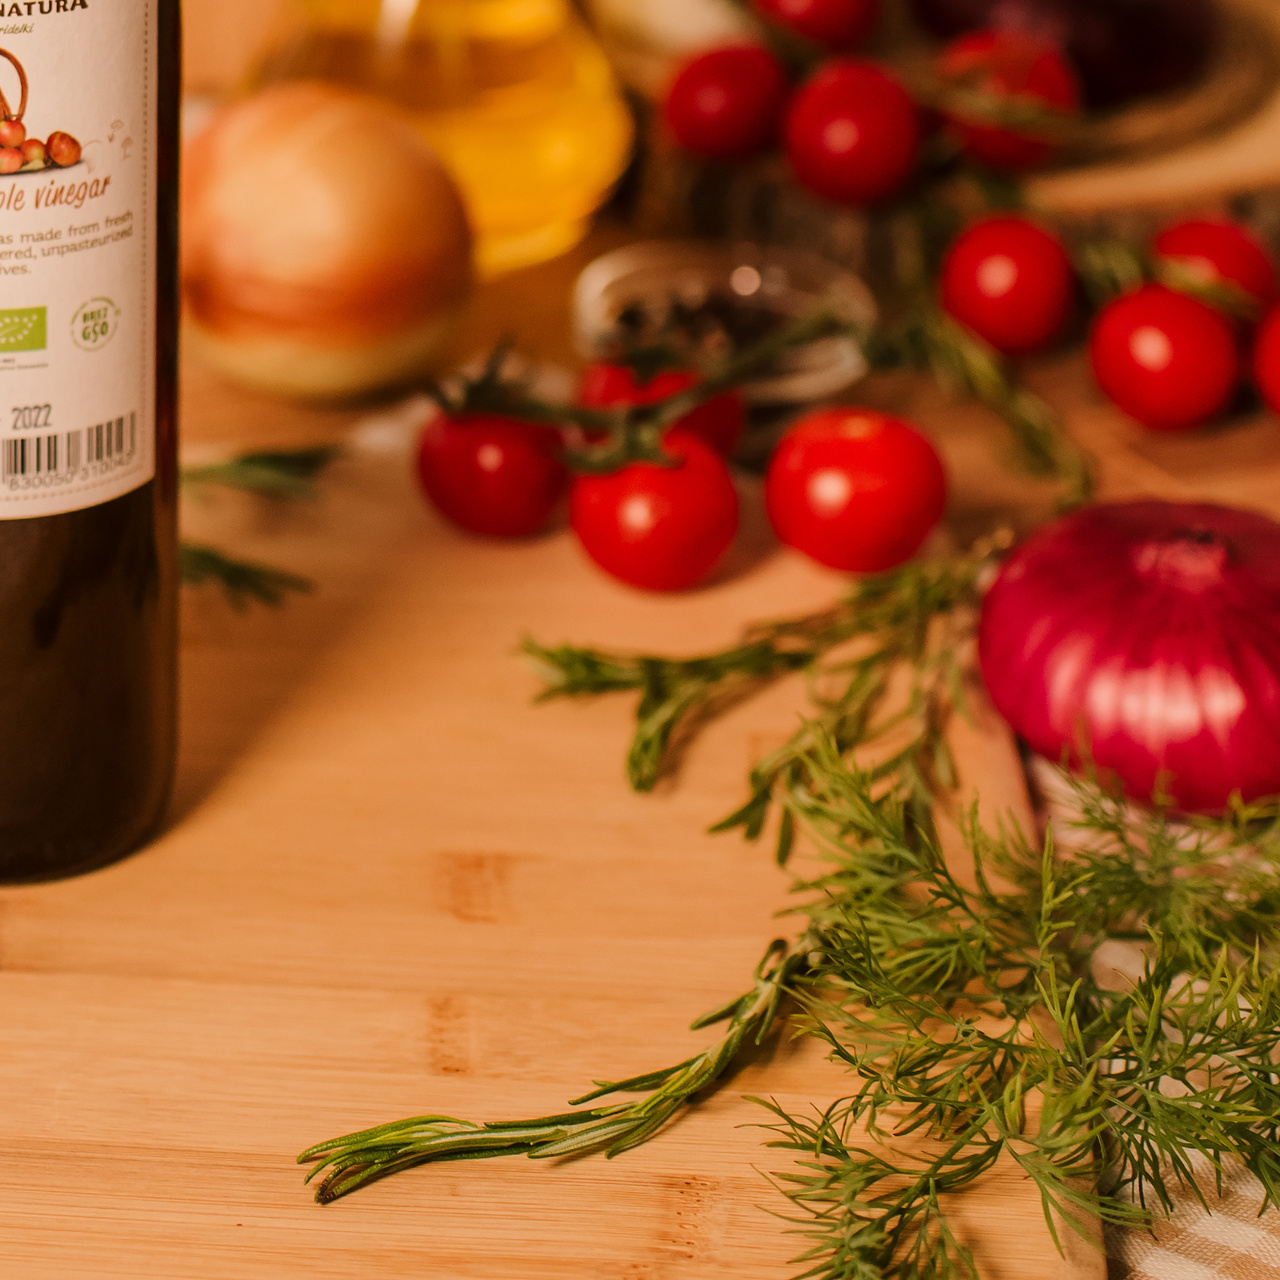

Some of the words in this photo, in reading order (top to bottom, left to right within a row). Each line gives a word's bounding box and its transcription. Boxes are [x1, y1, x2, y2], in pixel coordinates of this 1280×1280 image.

[34, 176, 112, 209] vinegar
[20, 228, 62, 243] made
[68, 222, 100, 237] from
[105, 210, 133, 228] fresh
[41, 224, 133, 257] unpasteurized
